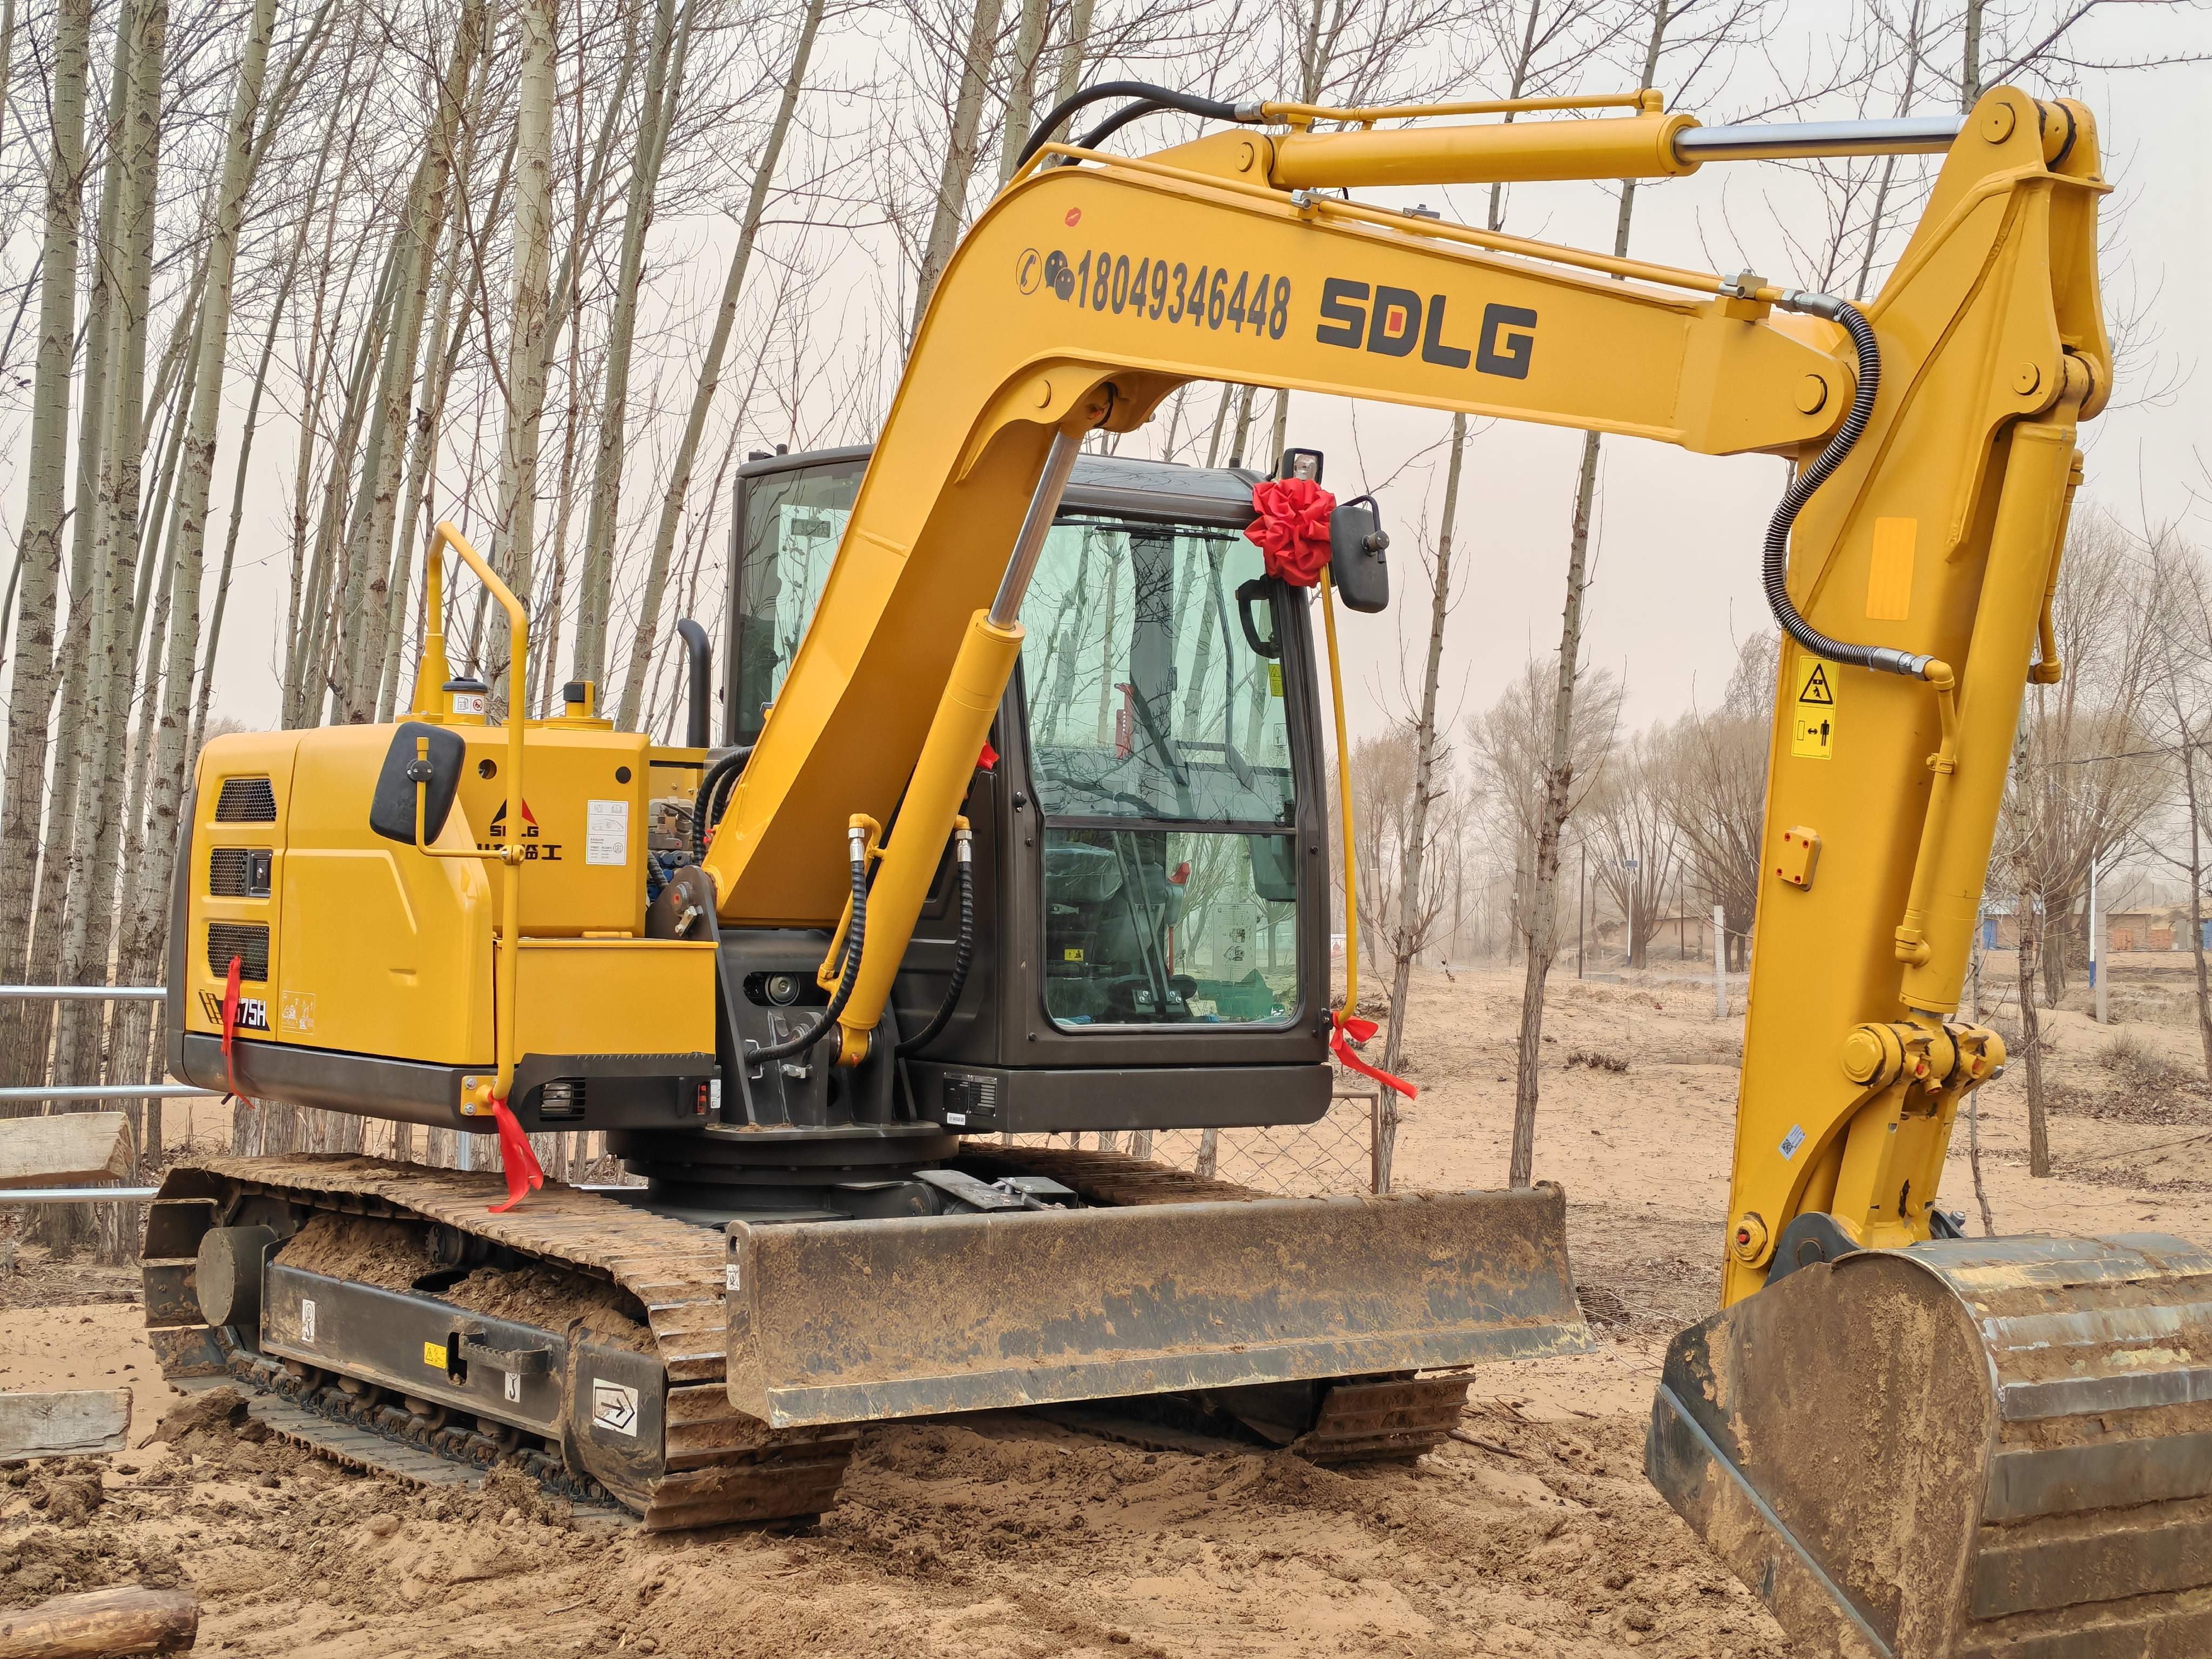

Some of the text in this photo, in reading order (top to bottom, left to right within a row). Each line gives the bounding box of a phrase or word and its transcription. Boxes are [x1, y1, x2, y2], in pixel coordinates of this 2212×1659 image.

[1078, 249, 1292, 340] 18049346448
[1316, 277, 1538, 380] SDLG
[490, 825, 539, 838] SG
